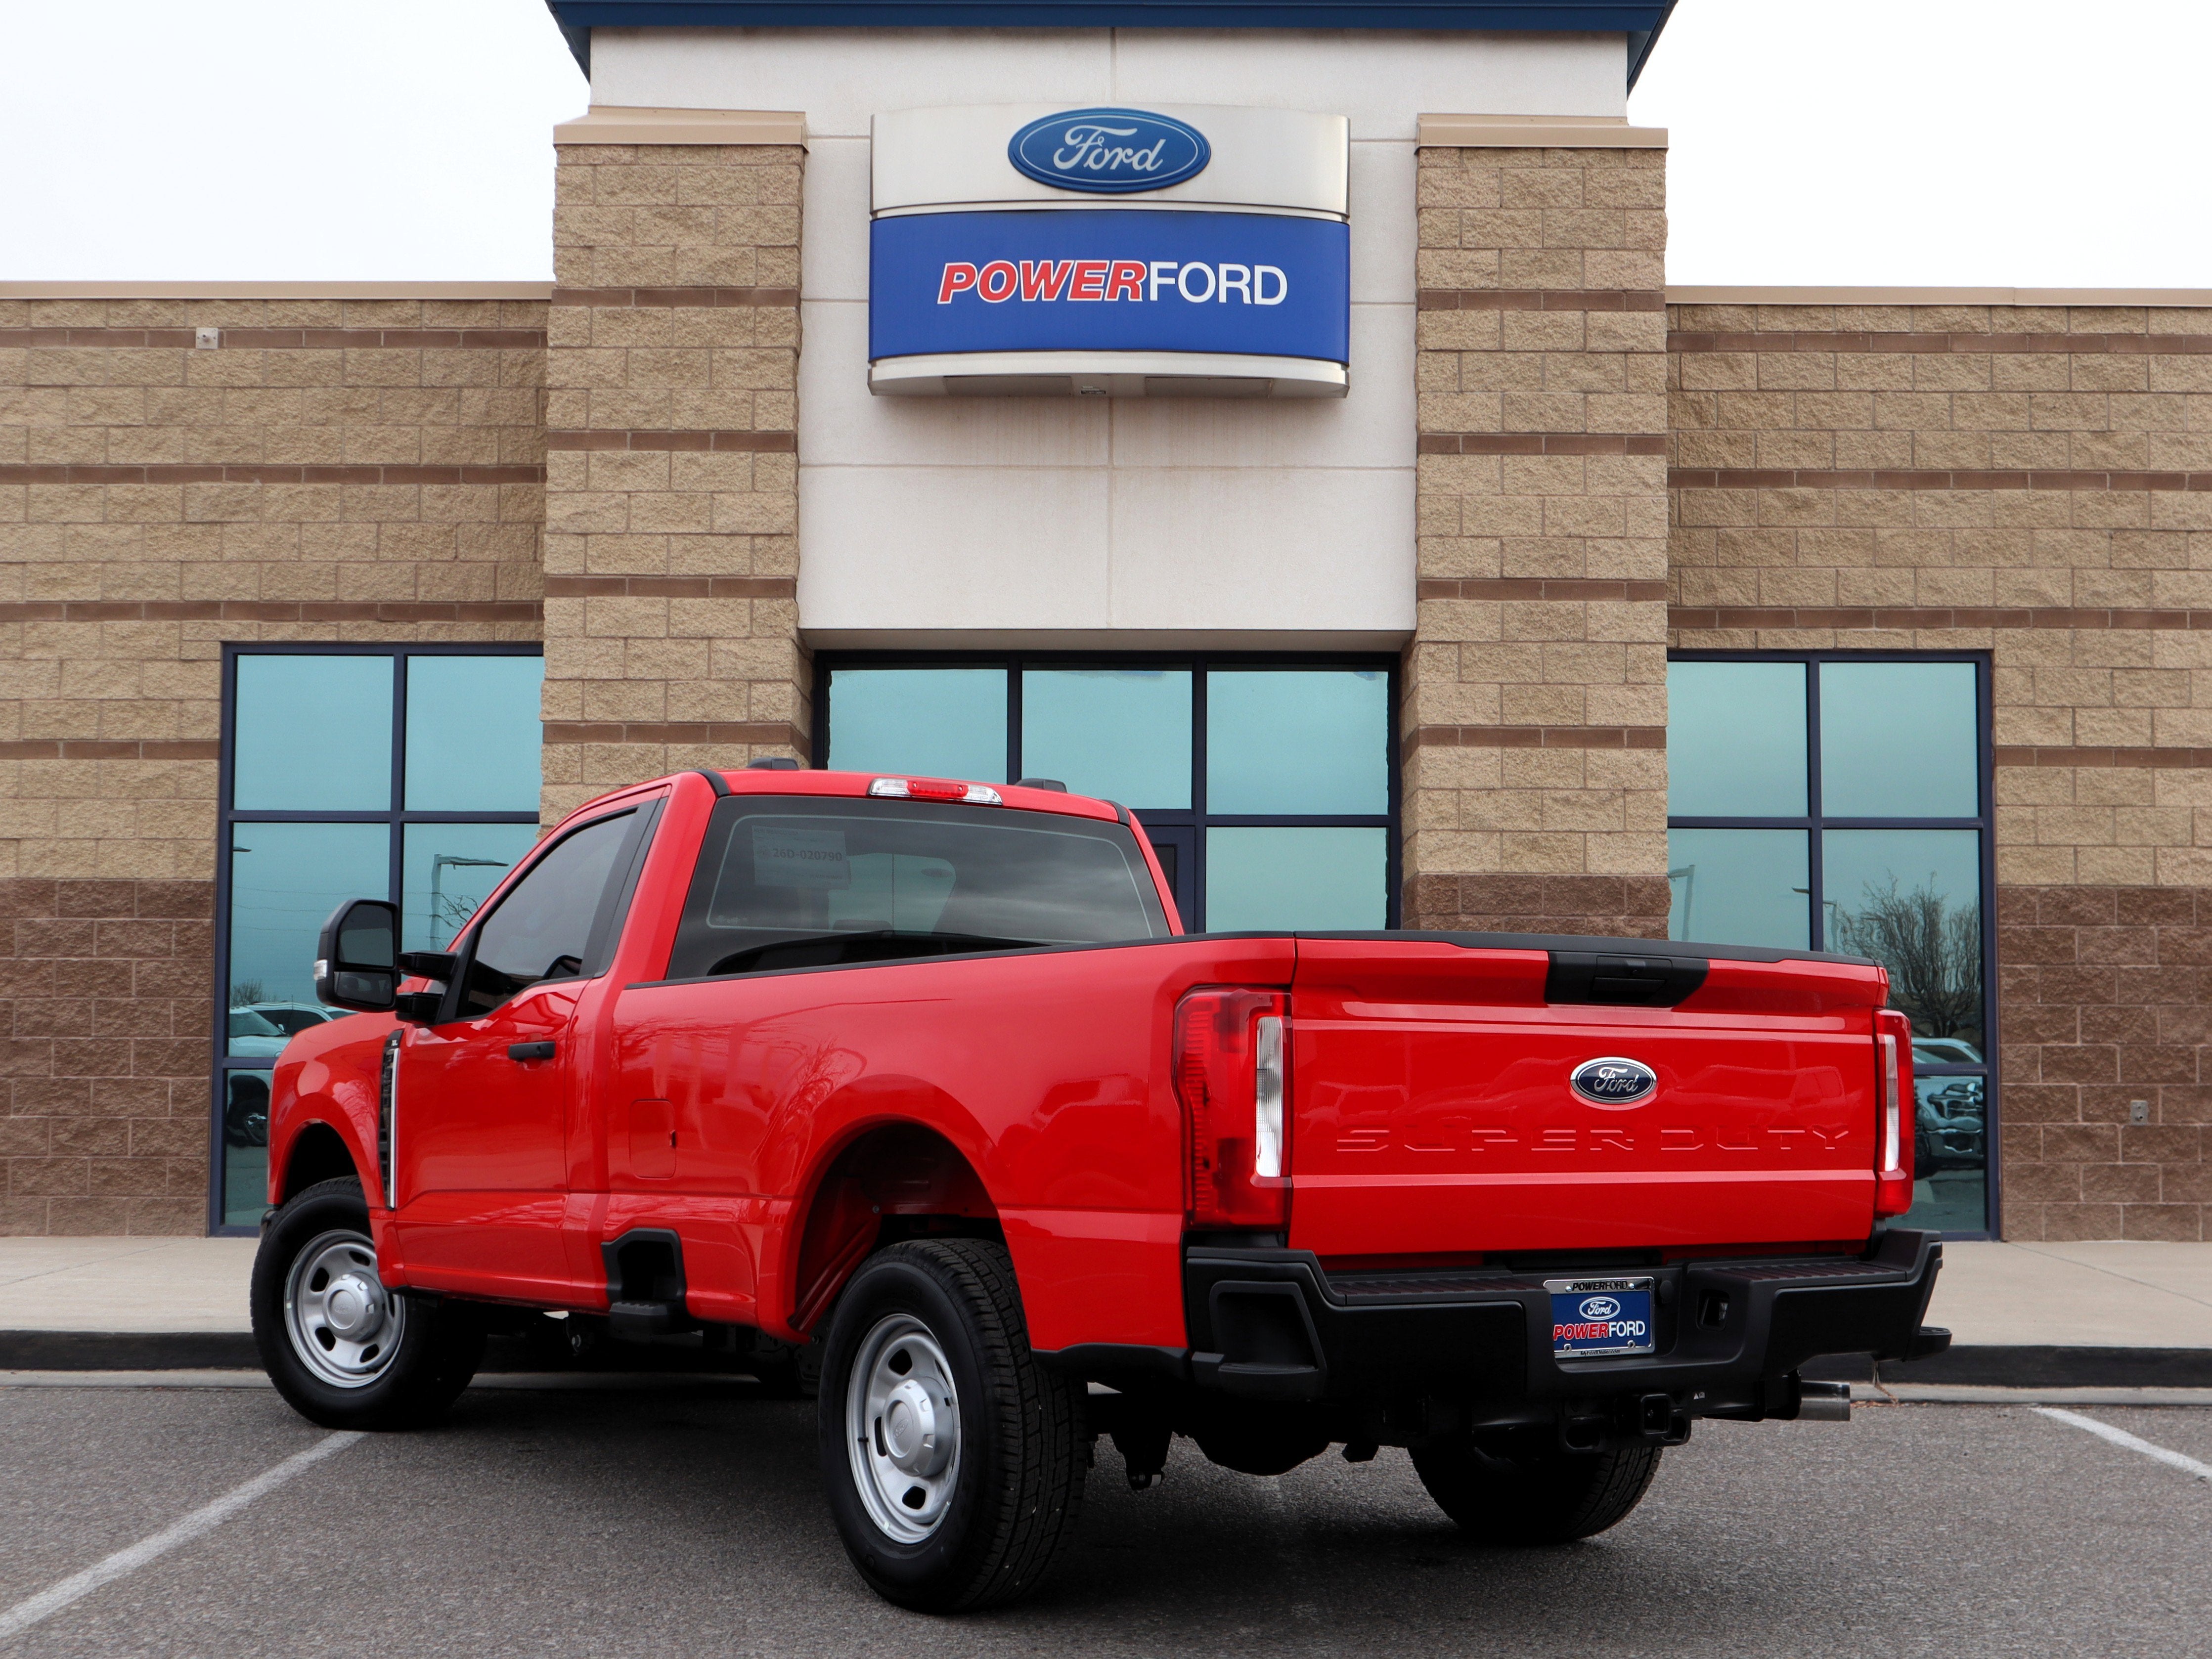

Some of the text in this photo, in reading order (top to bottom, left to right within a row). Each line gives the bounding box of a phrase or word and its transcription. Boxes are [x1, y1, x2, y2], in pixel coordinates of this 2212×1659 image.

[1053, 125, 1166, 172] Ford
[937, 260, 1287, 306] POWERFORD
[1594, 1067, 1639, 1092] Ford
[1337, 1125, 1849, 1152] SUPER DUTY
[1588, 1301, 1612, 1315] Ford
